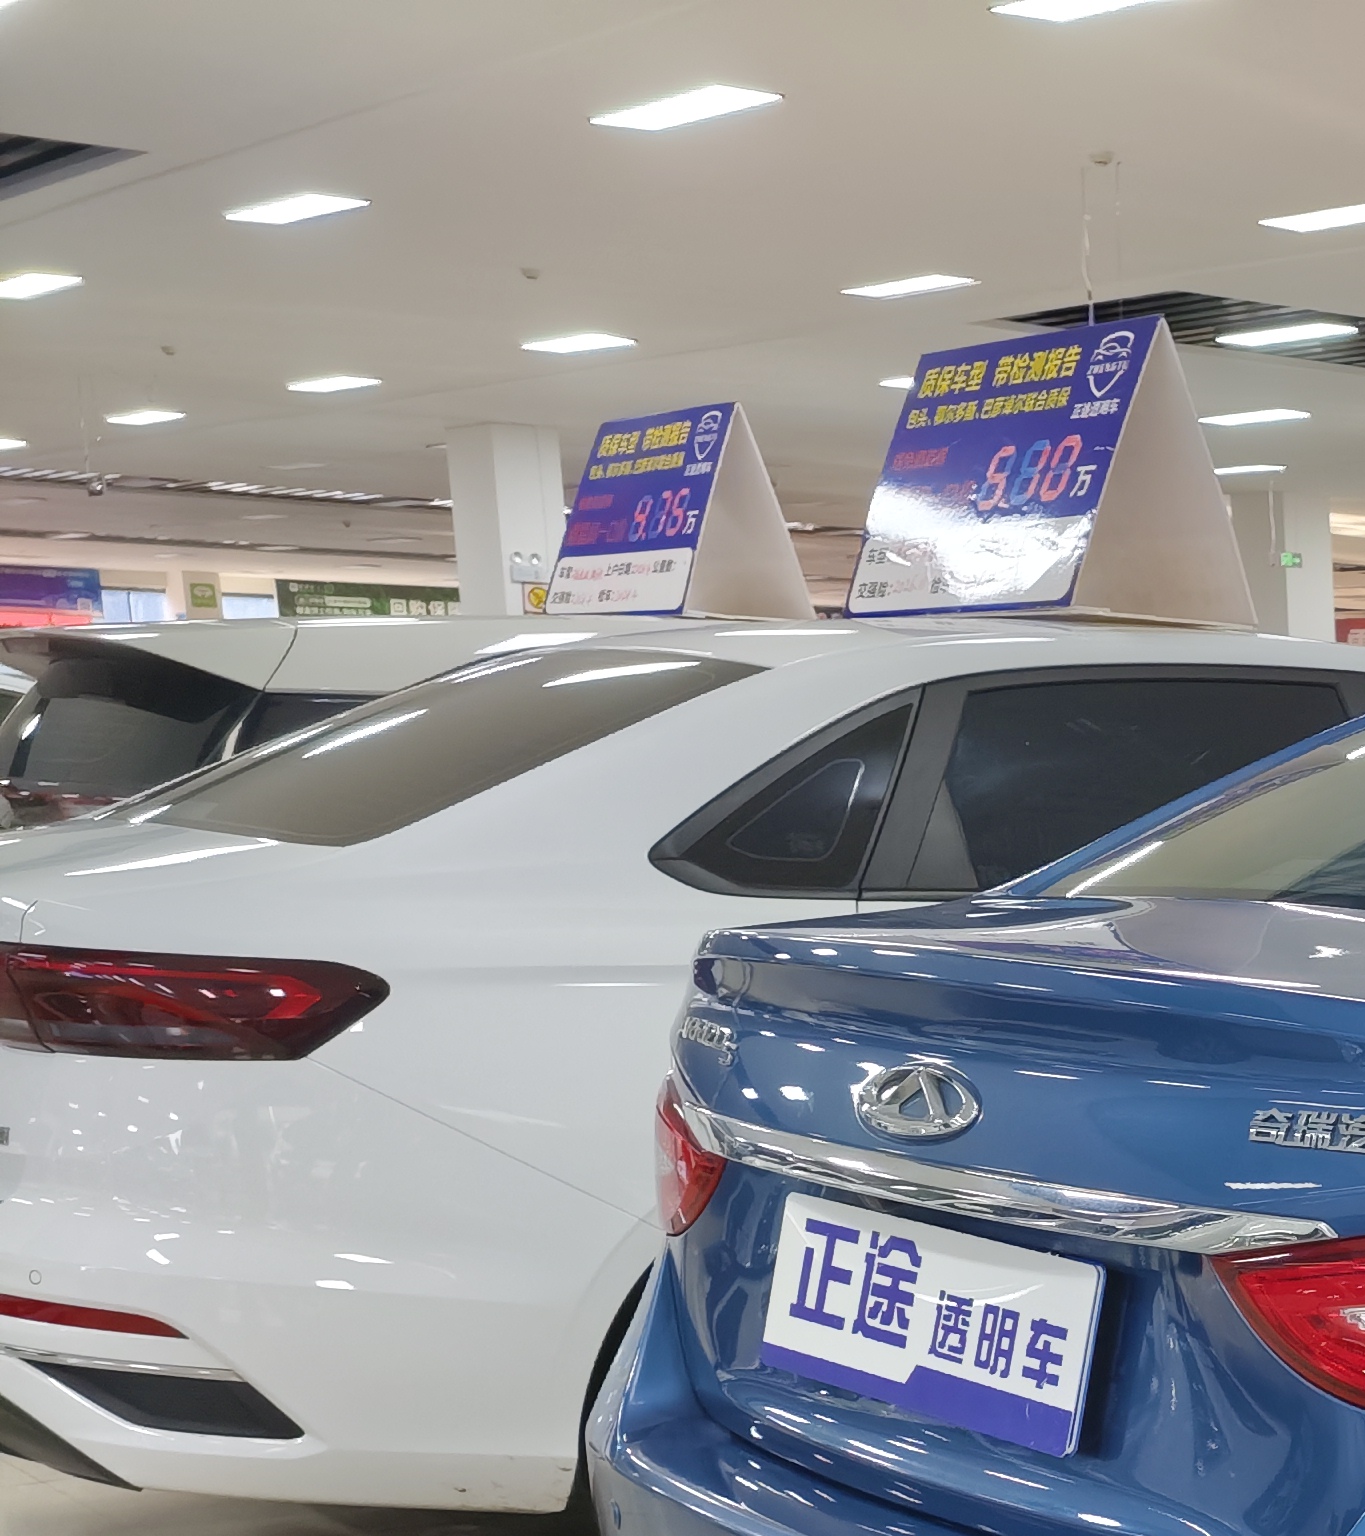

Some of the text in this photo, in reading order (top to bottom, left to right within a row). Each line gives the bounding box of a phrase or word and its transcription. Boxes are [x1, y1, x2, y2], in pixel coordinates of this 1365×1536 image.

[917, 344, 1082, 399] 质保车型 带检测报告
[789, 1217, 1069, 1390] 正途 透明车
